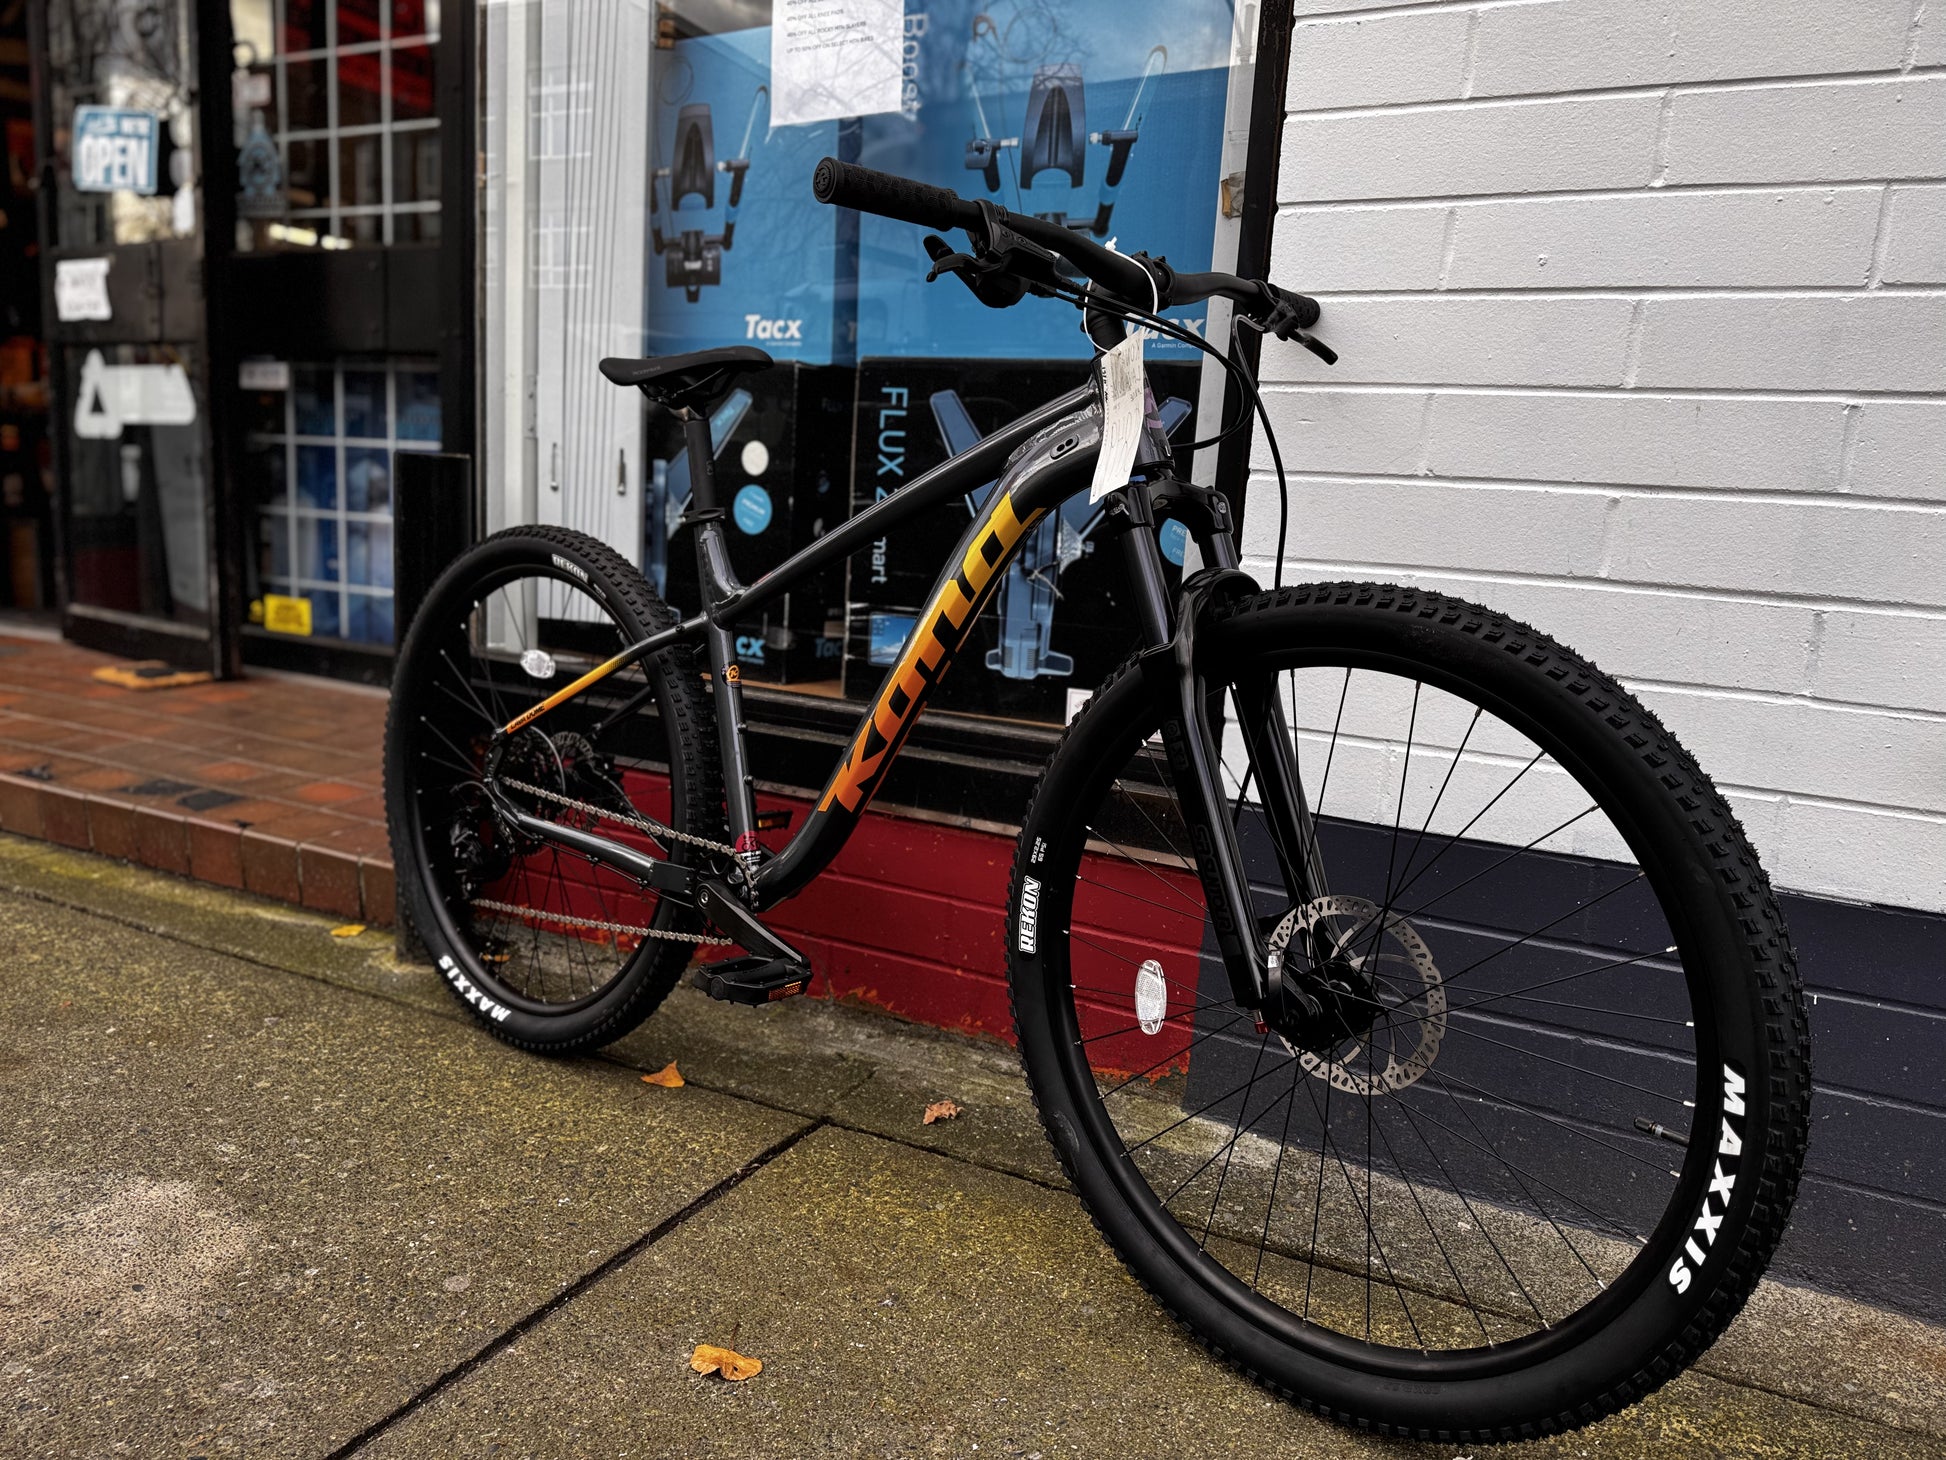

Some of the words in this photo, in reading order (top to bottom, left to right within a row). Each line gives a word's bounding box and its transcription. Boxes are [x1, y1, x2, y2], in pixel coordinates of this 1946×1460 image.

[80, 134, 150, 187] OPEN
[745, 314, 802, 339] Tacx
[876, 386, 909, 478] FLUX
[871, 536, 888, 585] mart
[736, 636, 766, 657] cx
[815, 638, 843, 658] Tac
[1019, 875, 1042, 955] REKON
[438, 954, 512, 1022] MAXXIS
[1668, 1063, 1746, 1295] MAXXIS
